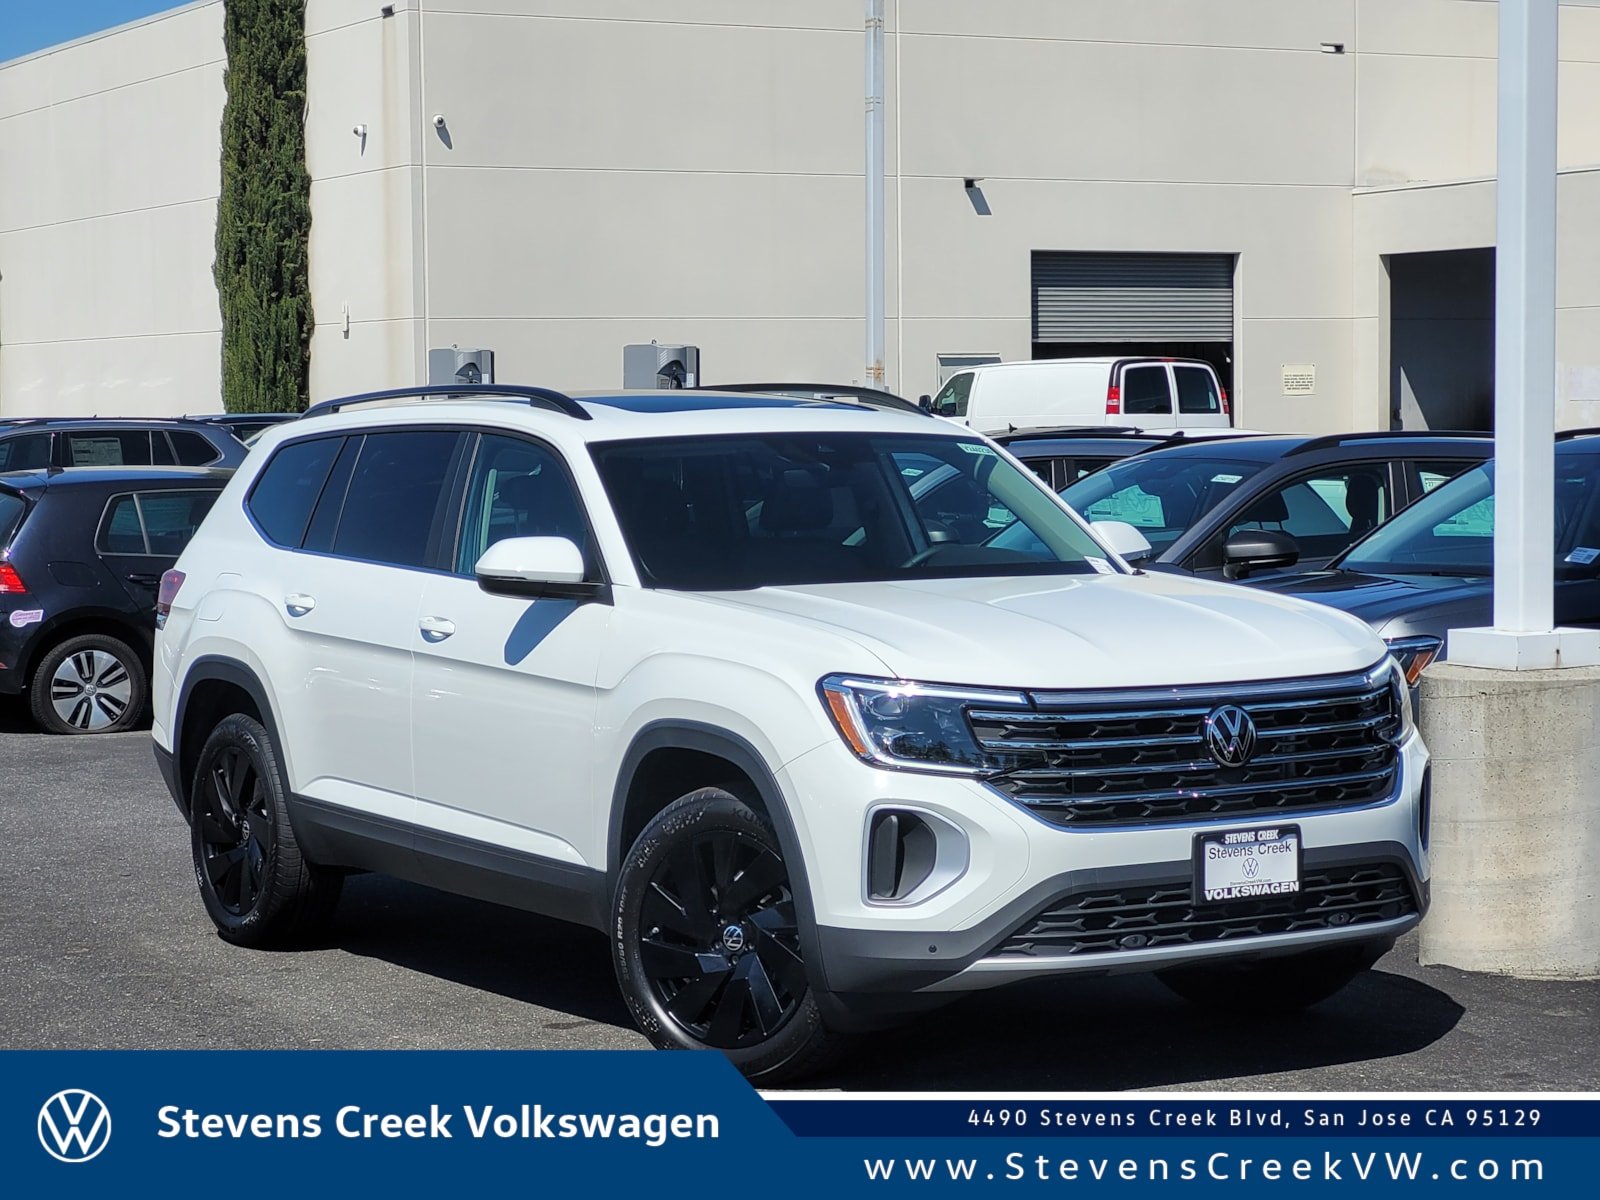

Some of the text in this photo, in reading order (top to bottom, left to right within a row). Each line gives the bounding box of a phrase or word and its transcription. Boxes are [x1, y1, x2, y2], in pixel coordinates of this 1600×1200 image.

[1224, 829, 1279, 845] STEVENS CREEK
[1208, 841, 1292, 860] Stevens Creek
[1204, 881, 1299, 901] VOLKSWAGEN
